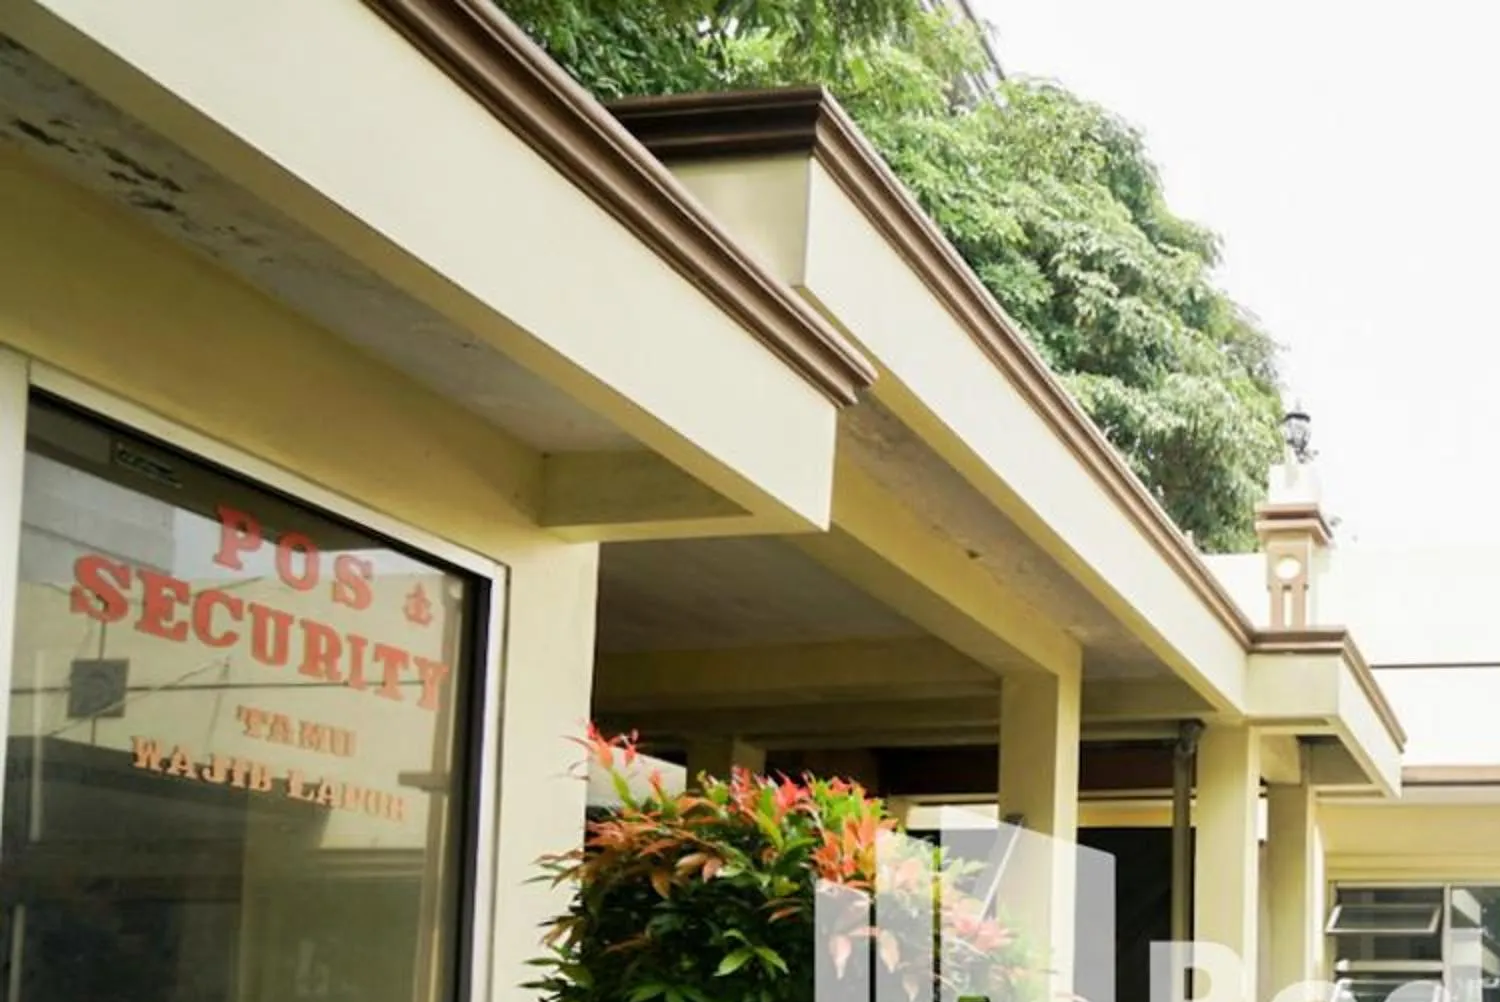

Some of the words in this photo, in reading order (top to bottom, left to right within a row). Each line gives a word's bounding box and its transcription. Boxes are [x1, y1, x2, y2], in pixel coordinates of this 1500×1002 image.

[214, 504, 373, 610] POS
[70, 554, 448, 711] SECURITY
[130, 735, 273, 792] WAJIB
[237, 705, 356, 757] TAMU
